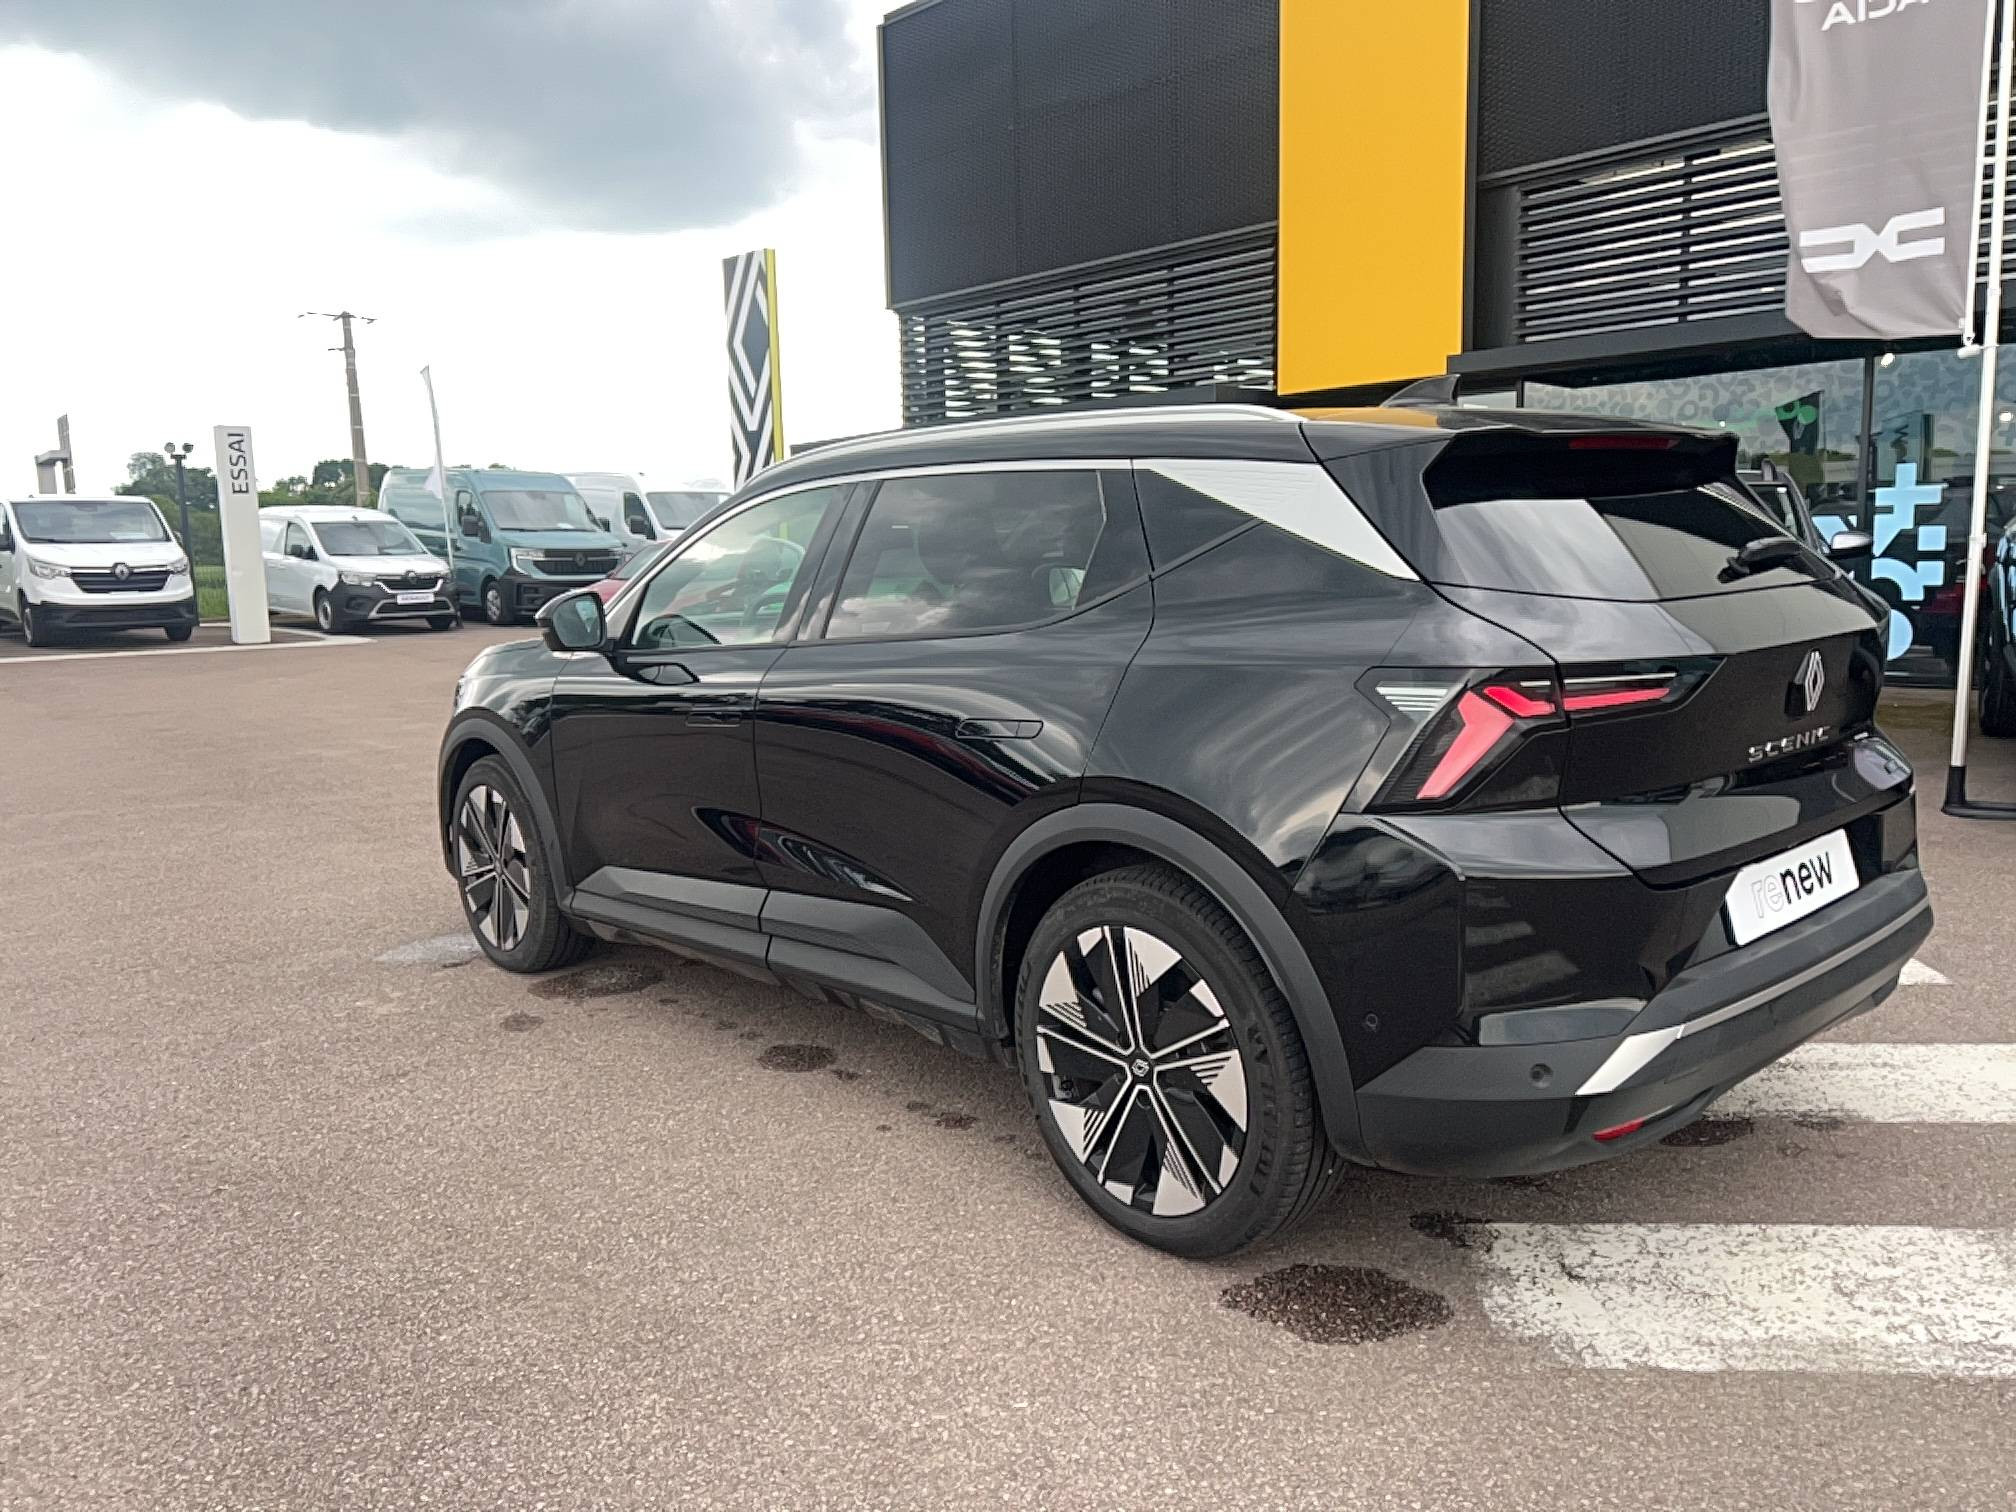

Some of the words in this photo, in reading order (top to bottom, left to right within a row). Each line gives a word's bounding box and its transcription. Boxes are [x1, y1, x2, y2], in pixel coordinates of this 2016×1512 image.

[227, 432, 249, 494] ESSAI
[1748, 725, 1831, 763] SCENIC
[1750, 850, 1833, 919] renew
